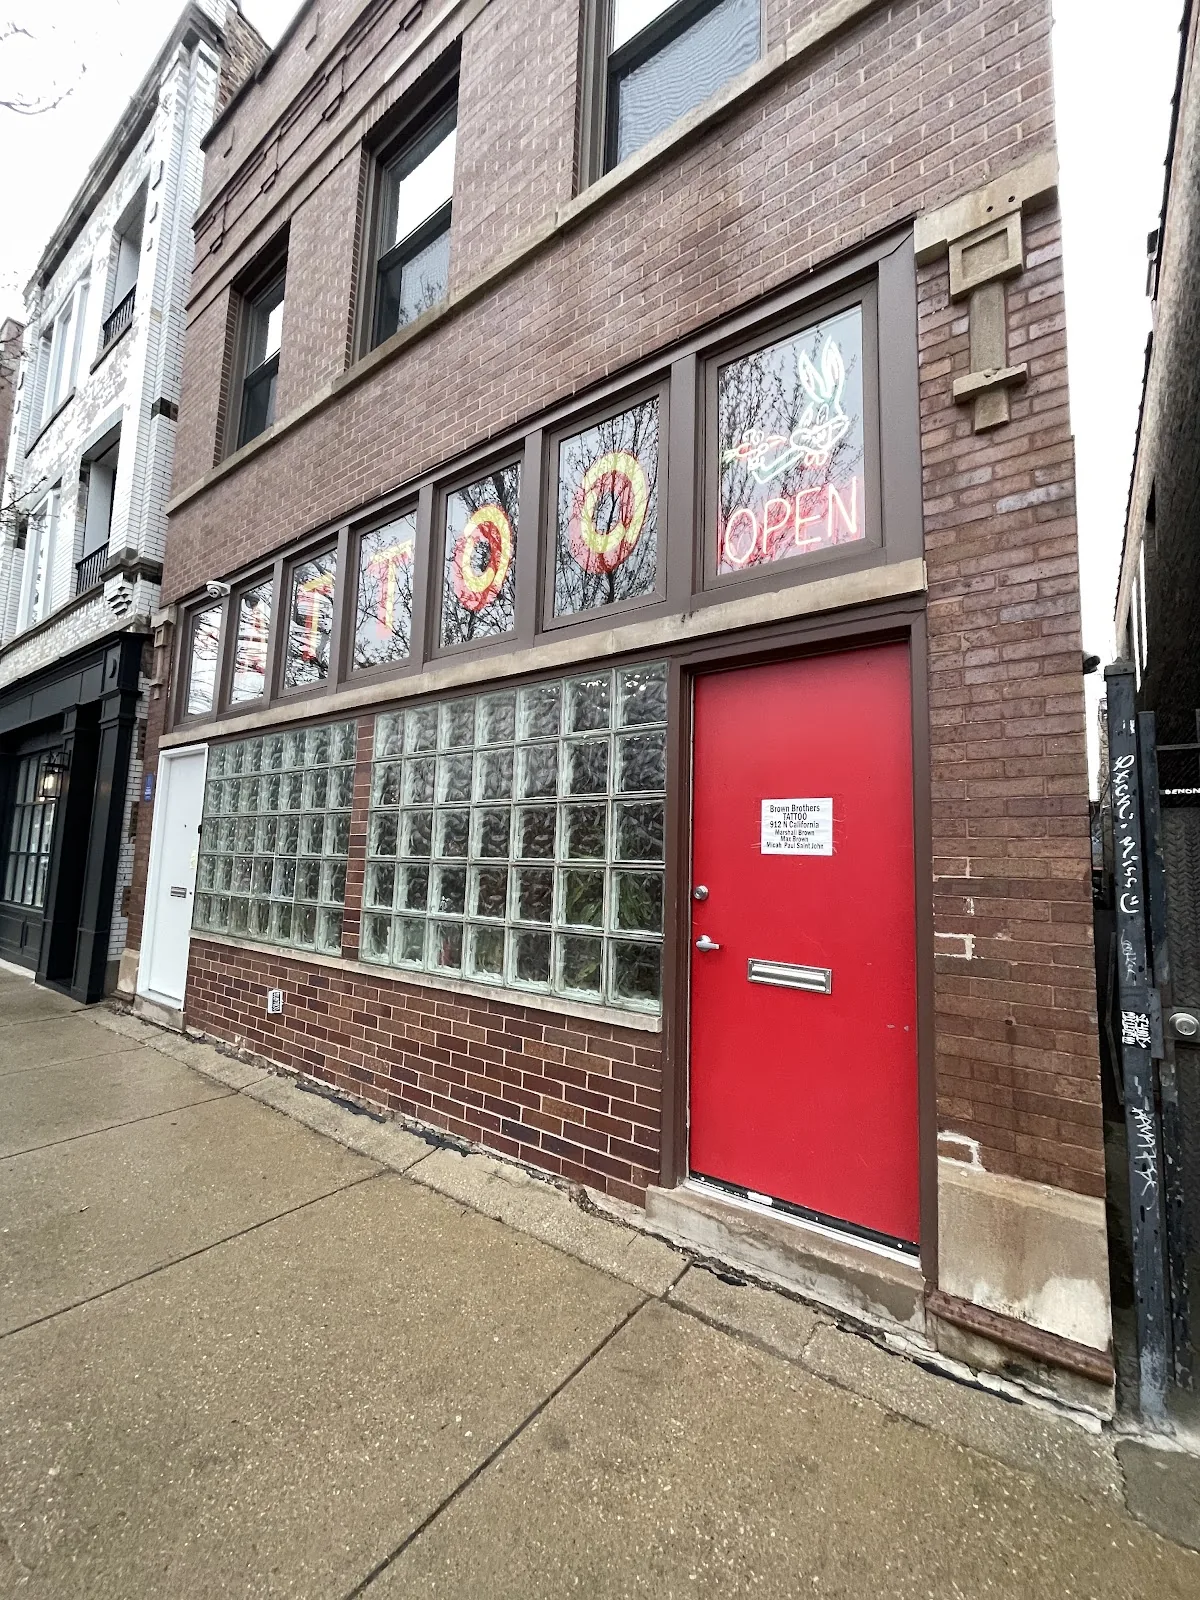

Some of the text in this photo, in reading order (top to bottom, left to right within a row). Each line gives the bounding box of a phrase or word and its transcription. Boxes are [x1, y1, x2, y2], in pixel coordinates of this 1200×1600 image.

[725, 476, 858, 563] OPEN
[769, 804, 820, 813] Brown Brothers
[782, 812, 807, 820] TATTOO
[789, 820, 820, 828] California
